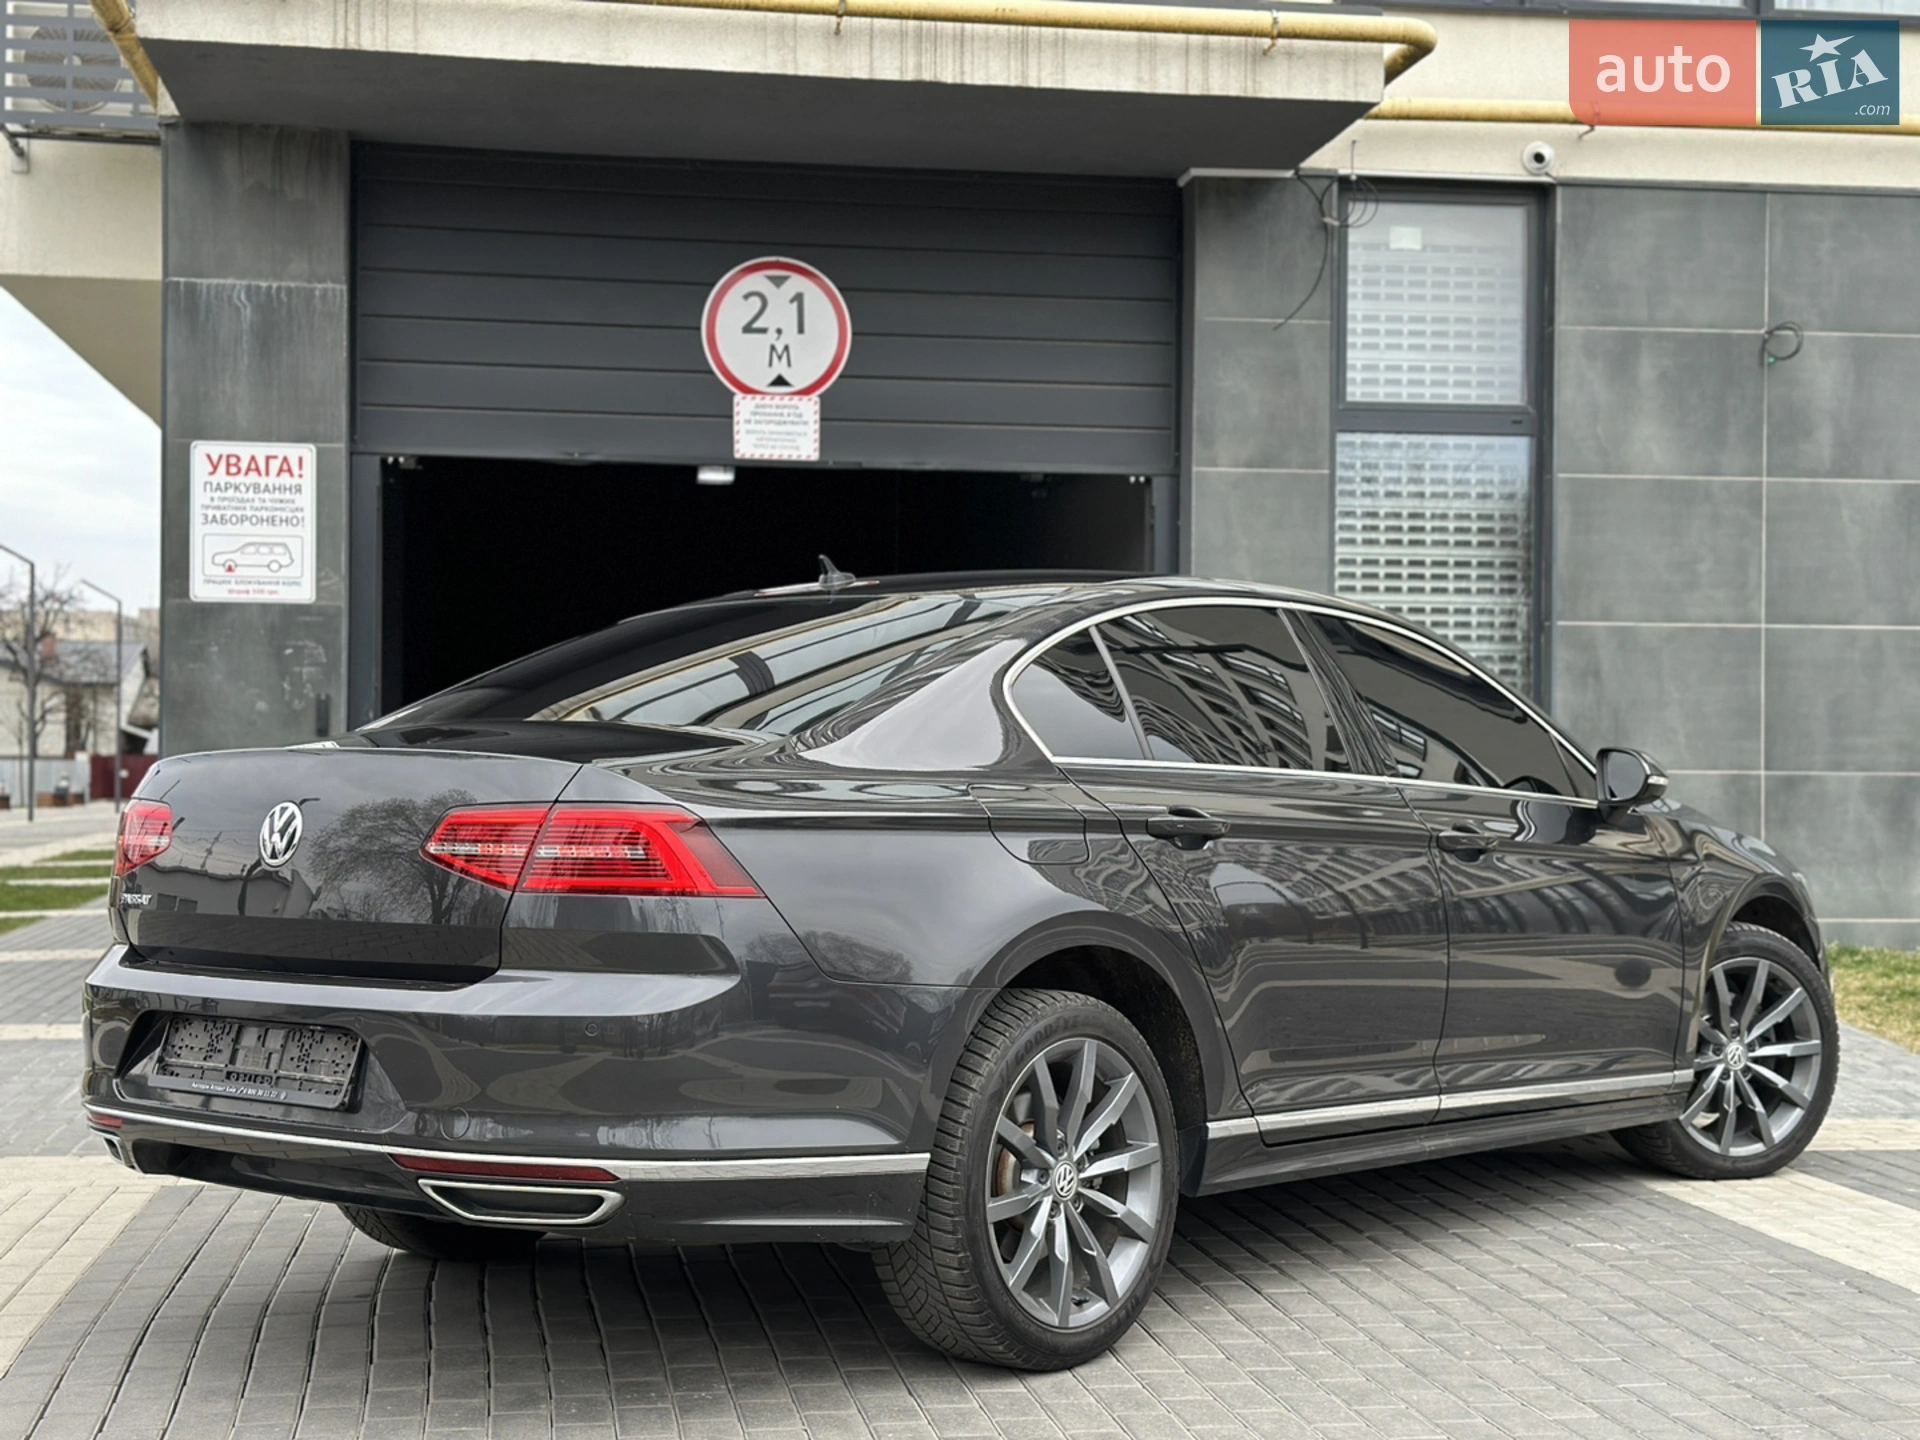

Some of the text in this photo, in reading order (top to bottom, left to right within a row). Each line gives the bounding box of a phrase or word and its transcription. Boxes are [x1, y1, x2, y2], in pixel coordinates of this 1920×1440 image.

[741, 290, 805, 341] 2,1
[205, 453, 304, 478] УВАГА!
[203, 481, 303, 495] ПАРКУВАННЯ
[201, 513, 305, 528] ЗАБОРОНЕНО!
